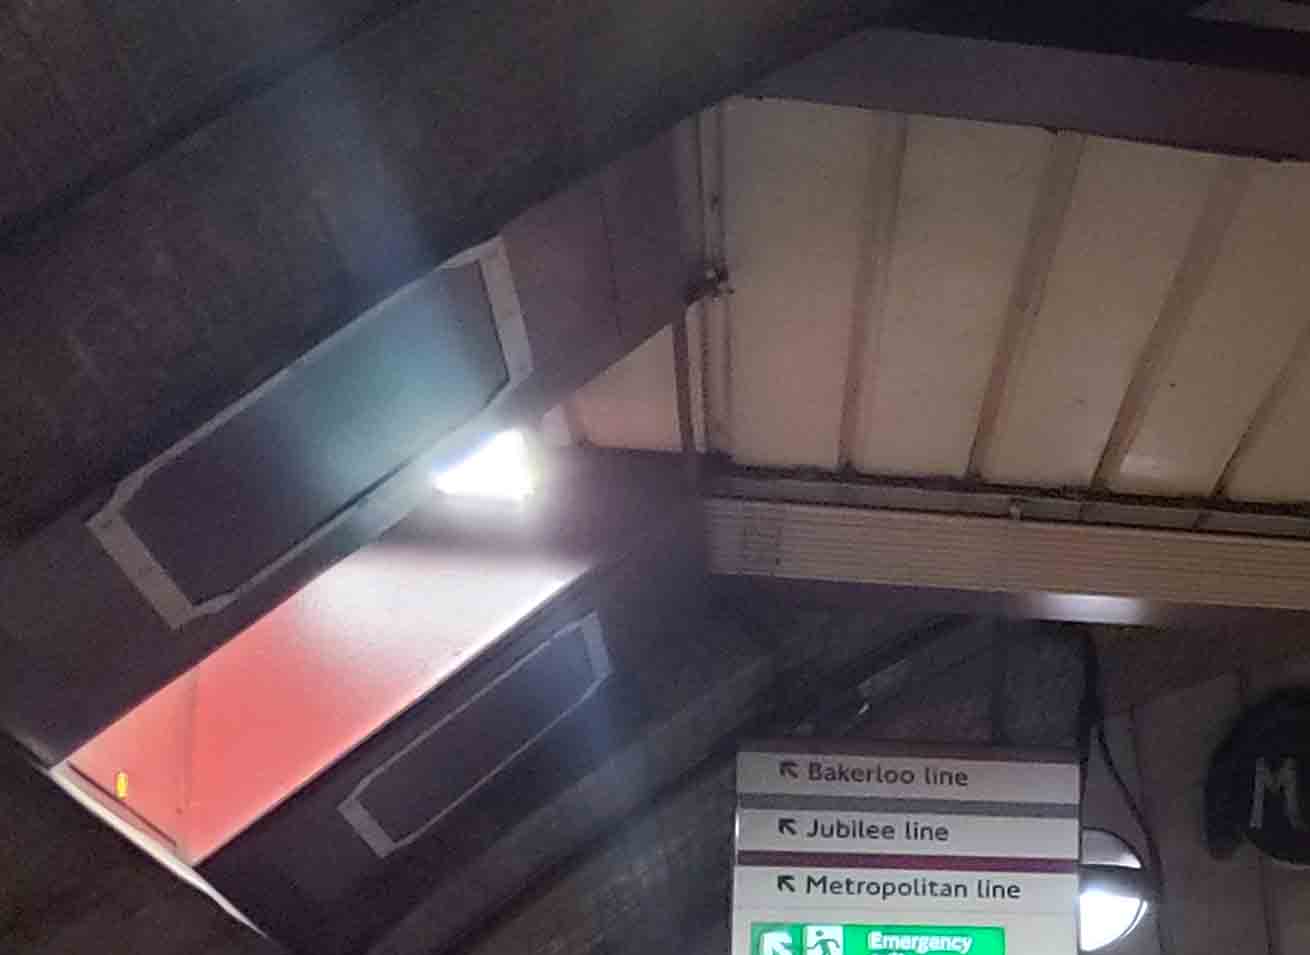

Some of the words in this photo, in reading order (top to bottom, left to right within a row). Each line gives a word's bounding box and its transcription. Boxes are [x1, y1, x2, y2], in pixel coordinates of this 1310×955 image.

[807, 762, 915, 786] Bakerloo
[924, 766, 969, 787] line
[805, 819, 896, 840] Jubilee
[904, 822, 949, 842] line
[805, 875, 968, 901] Metropolitan
[977, 879, 1021, 900] line
[867, 931, 974, 954] Emergency
